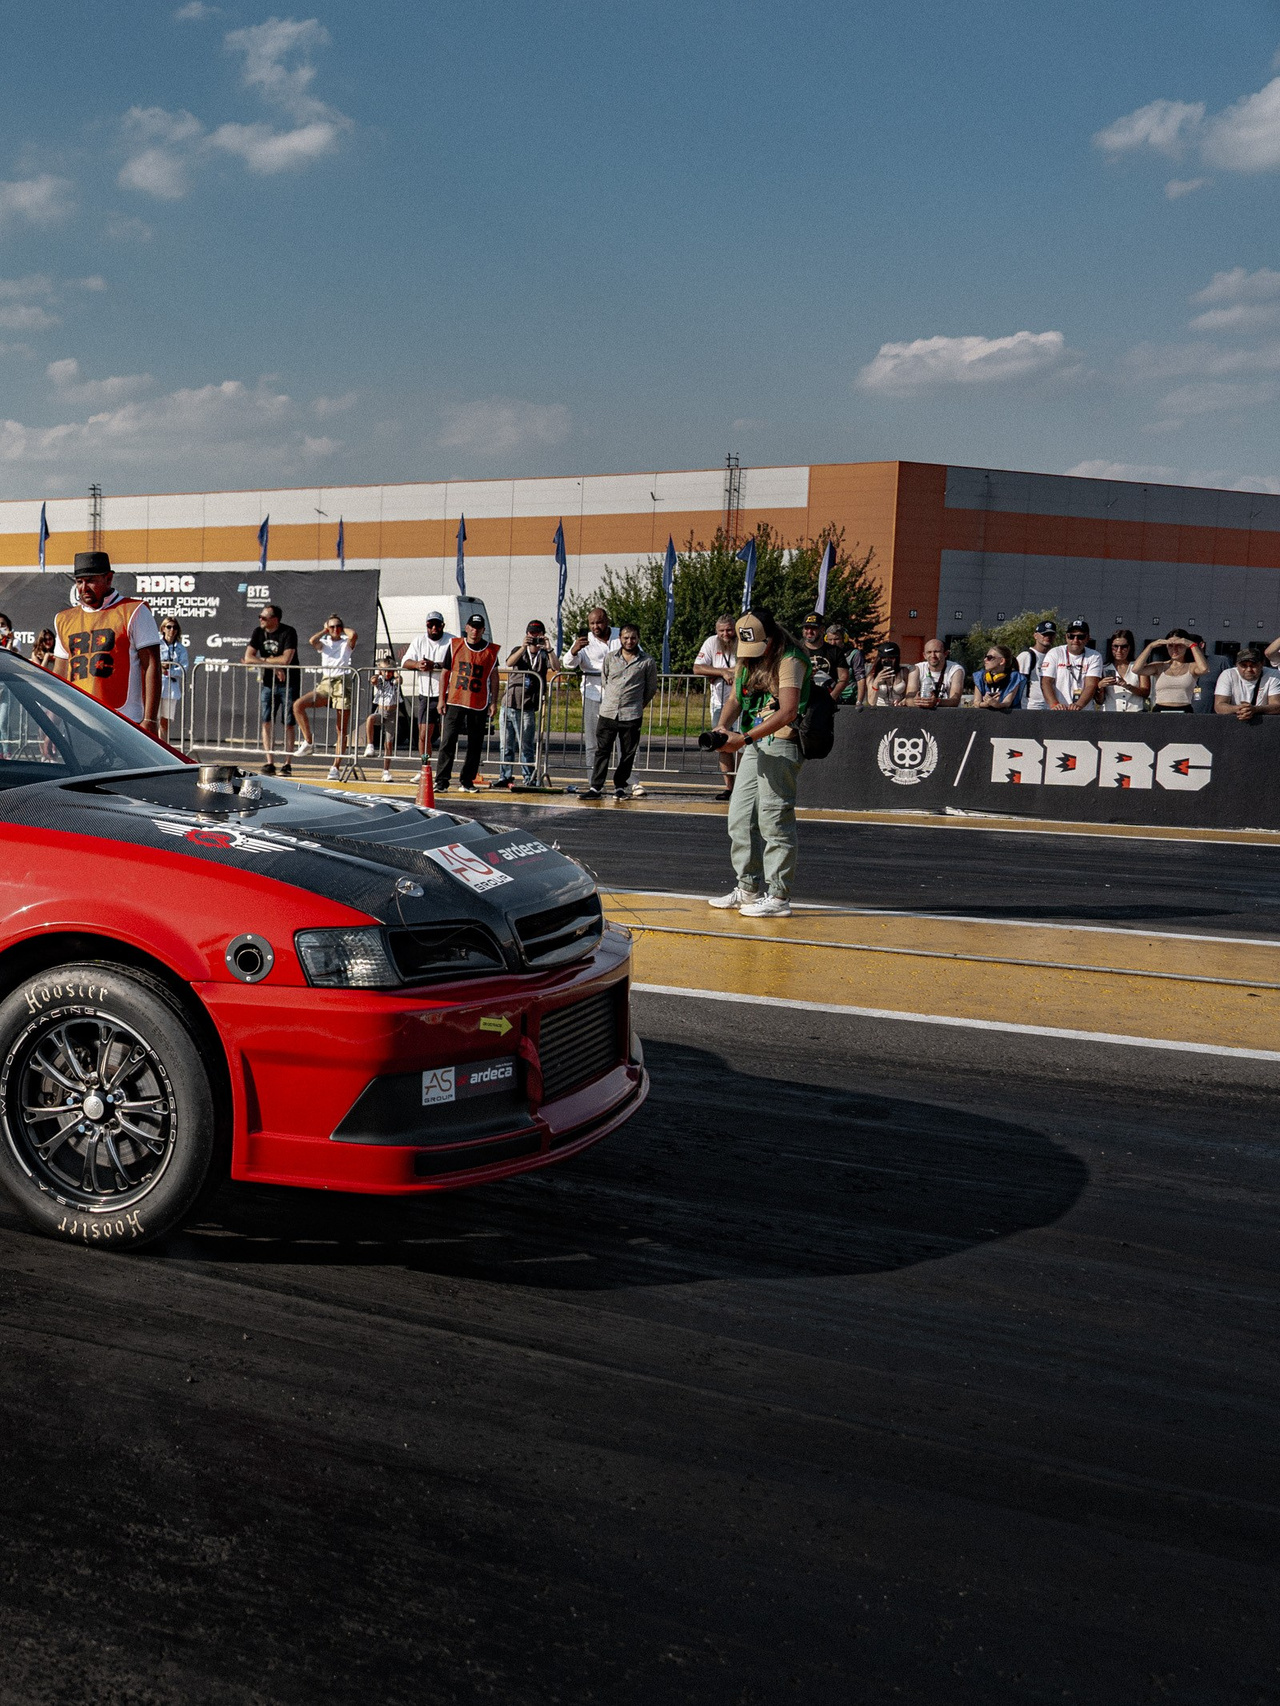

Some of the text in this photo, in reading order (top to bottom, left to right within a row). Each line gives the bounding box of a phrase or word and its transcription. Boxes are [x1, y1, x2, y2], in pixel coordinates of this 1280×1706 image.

[135, 575, 196, 593] RDRC
[247, 585, 270, 598] ВТБ
[176, 596, 220, 607] РОССИИ
[990, 737, 1213, 792] RDRC
[498, 841, 549, 861] ardeca
[473, 875, 509, 891] GROUP
[24, 982, 108, 1015] Hoosier
[27, 1007, 95, 1033] RACING
[0, 1054, 15, 1114] WELD
[424, 1069, 453, 1095] AS
[470, 1066, 513, 1084] ardeca
[148, 1050, 176, 1142] FORGED
[424, 1094, 454, 1104] GROUP
[57, 1209, 144, 1244] Hoosier
